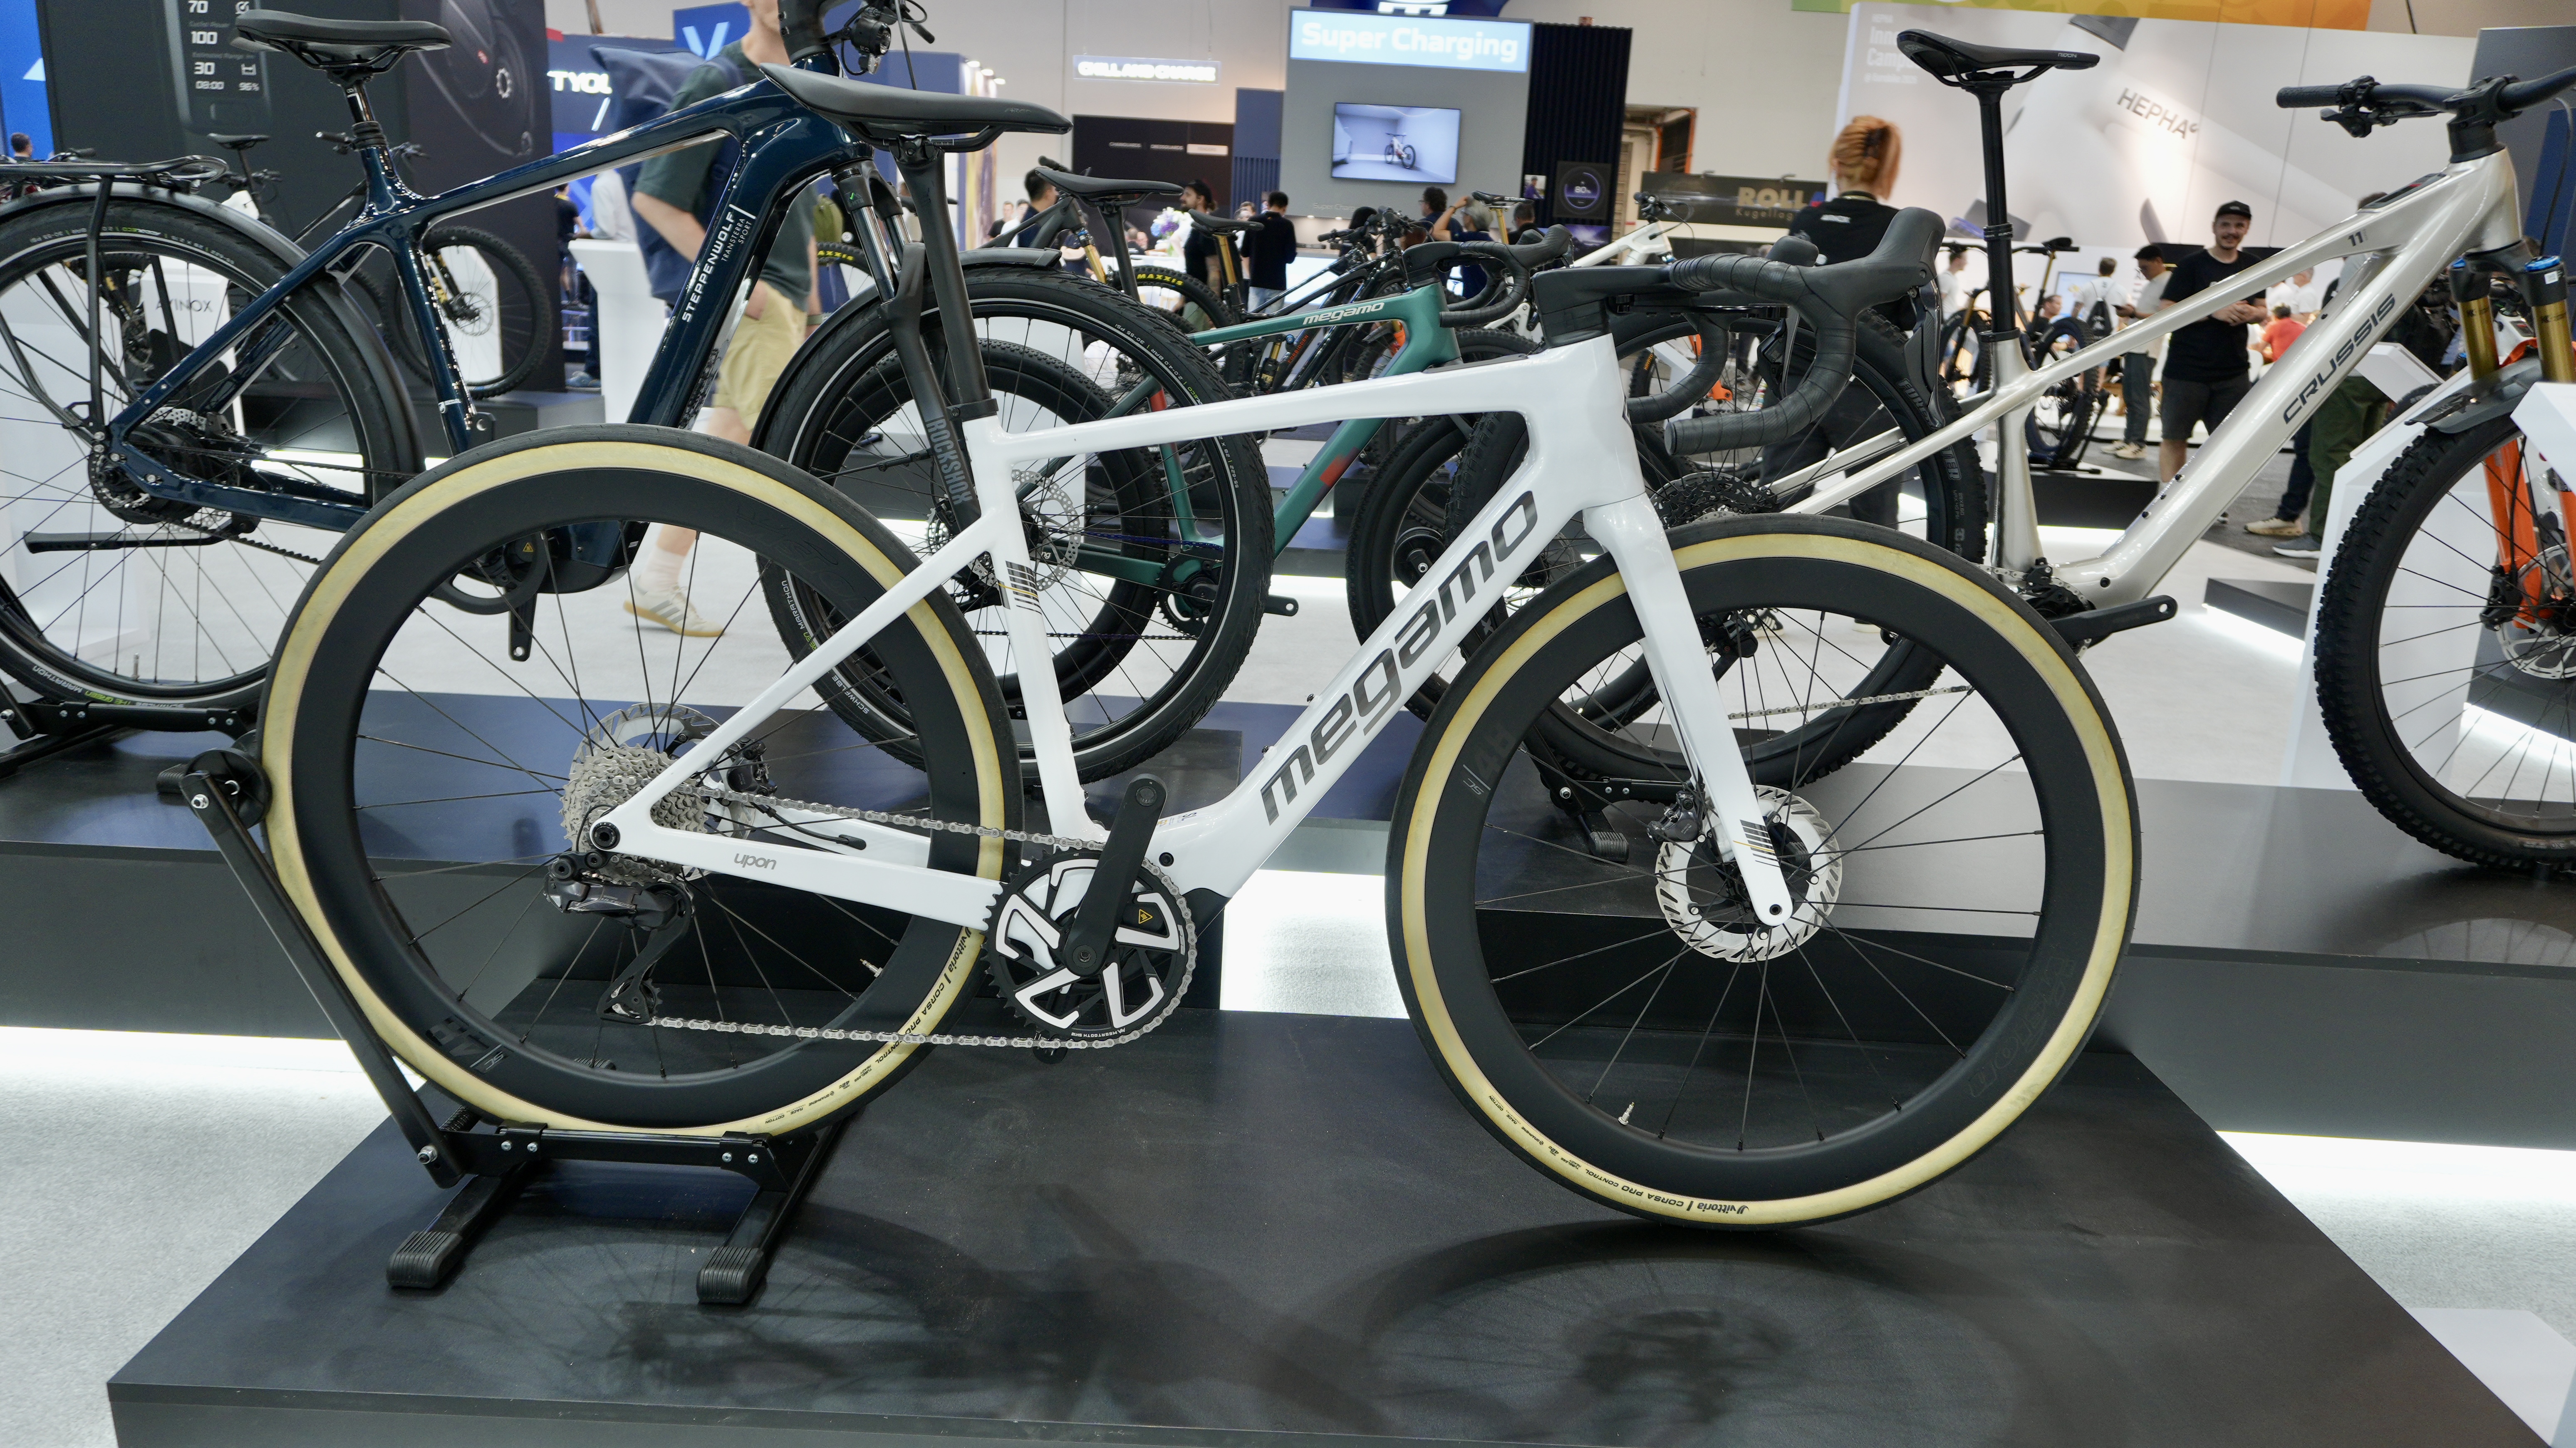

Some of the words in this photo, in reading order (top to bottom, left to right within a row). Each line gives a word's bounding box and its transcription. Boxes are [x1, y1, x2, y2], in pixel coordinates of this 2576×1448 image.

[188, 0, 208, 13] 70
[191, 31, 218, 45] 100
[1301, 22, 1387, 53] Super
[1391, 27, 1518, 62] Charging
[194, 62, 215, 75] 30
[2117, 87, 2189, 139] HEPHA
[1737, 186, 1808, 210] ROLL
[1736, 208, 1793, 221] Kugellag
[721, 218, 746, 263] TRANSTERRA
[738, 221, 752, 245] SPORT
[2348, 231, 2363, 246] 11
[817, 250, 854, 260] AXXIS
[681, 211, 735, 323] STEPPENWOLF
[1137, 273, 1184, 286] MAXXIS
[1303, 302, 1385, 325] megamo
[1115, 324, 1126, 332] PSI
[1127, 330, 1145, 345] 30-55
[1151, 348, 1164, 361] BAR
[1288, 334, 1310, 363] FORBIDDEN
[2283, 293, 2395, 424] CRUSSIS
[1164, 361, 1184, 381] 2.0-4.0
[1224, 449, 1230, 457] 28
[926, 418, 973, 505] ROCKSHOX
[1230, 465, 1239, 488] 55-622
[781, 580, 805, 630] MARATHON
[803, 632, 817, 651] REEN
[1261, 490, 1538, 827] megamo
[32, 665, 84, 694] MARATHON
[85, 690, 114, 702] GREEN
[734, 853, 777, 870] upon
[948, 935, 967, 973] vittoria
[921, 982, 944, 1016] CORSA
[808, 1093, 830, 1106] GRAPHENE
[1489, 1095, 1504, 1111] COTTON
[765, 1114, 785, 1124] COTTON
[790, 1107, 803, 1115] RACE
[1506, 1114, 1518, 1125] RACE
[1521, 1126, 1540, 1142] GRAPHENE
[1585, 1168, 1619, 1187] CONTROL
[1621, 1185, 1644, 1197] PRO
[1647, 1193, 1684, 1207] CORSA
[1697, 1202, 1737, 1214] vittoria
